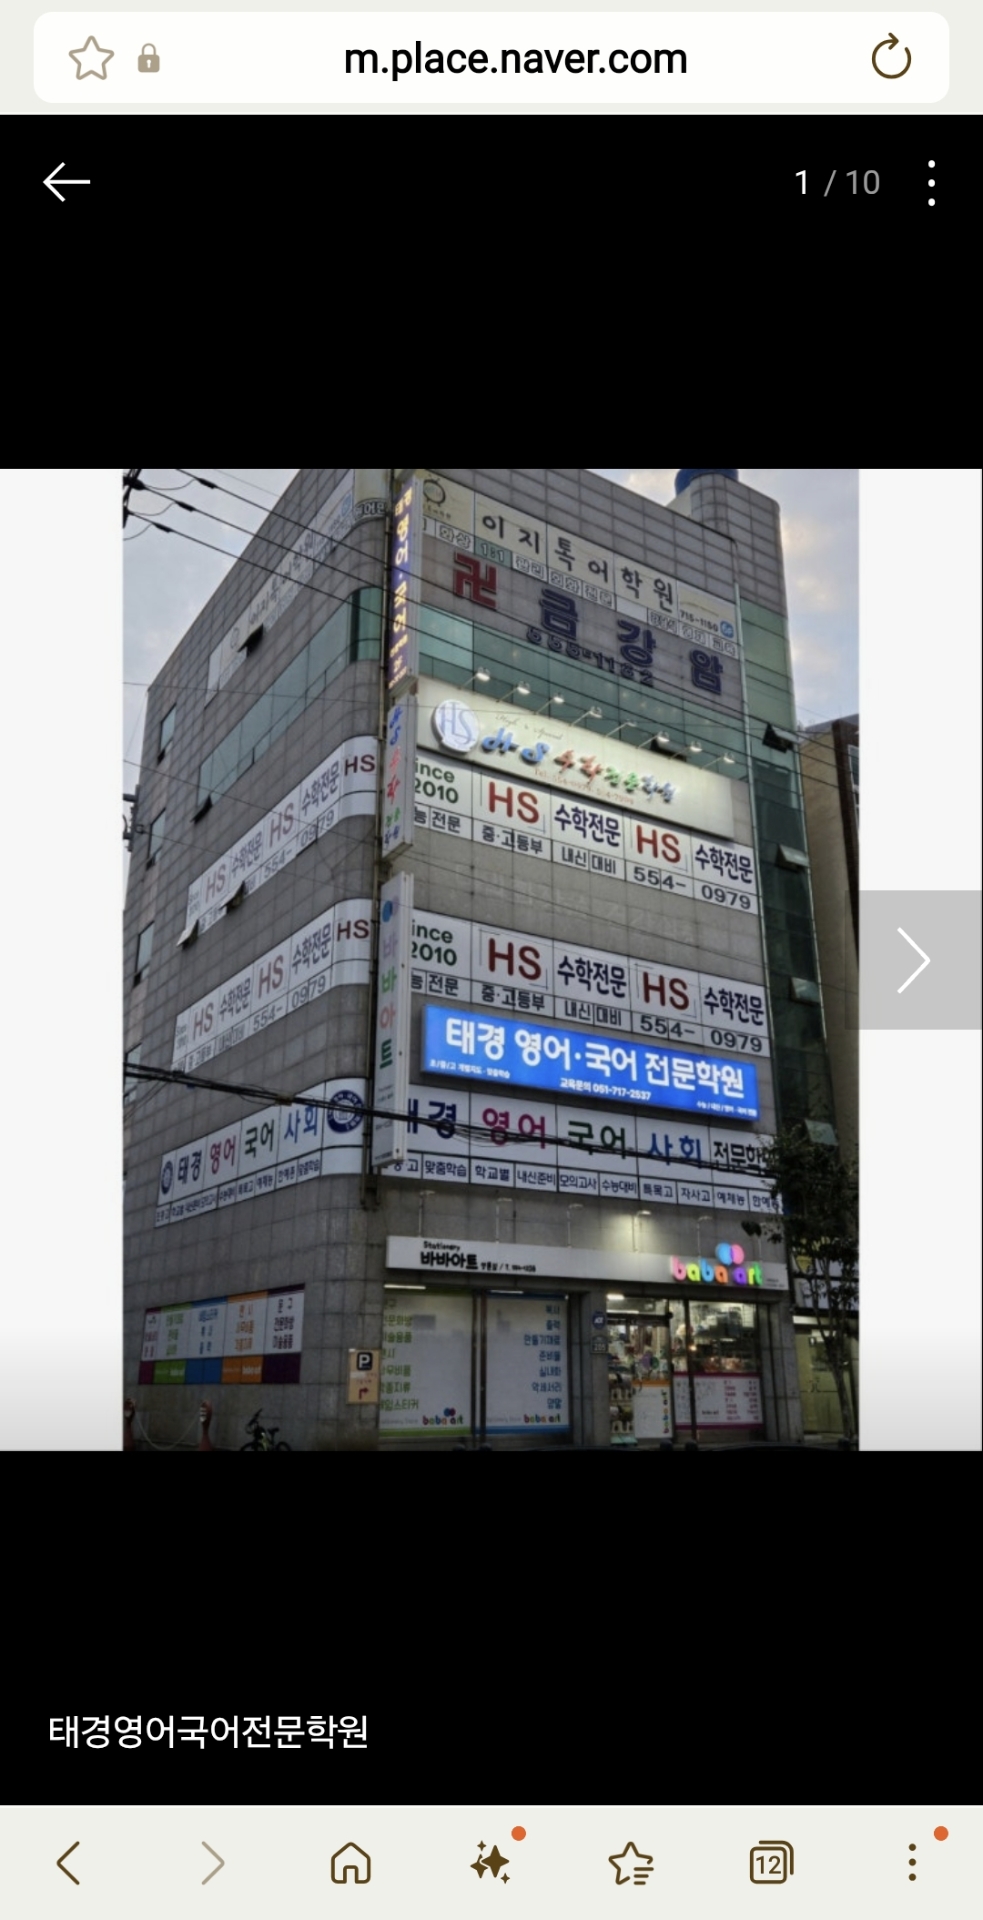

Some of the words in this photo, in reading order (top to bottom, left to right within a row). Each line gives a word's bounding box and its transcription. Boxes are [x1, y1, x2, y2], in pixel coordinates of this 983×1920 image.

[481, 542, 505, 564] 1:1
[540, 587, 724, 695] 금강암
[344, 754, 376, 777] HS
[414, 757, 455, 784] ince
[205, 863, 227, 903] HS
[269, 802, 295, 848] HS
[301, 759, 339, 817] 수학전문
[432, 810, 461, 834] 전문
[561, 846, 588, 868] 내신
[591, 853, 618, 876] 대비
[488, 781, 540, 825] HS
[553, 803, 621, 847] 수학전문
[635, 824, 682, 864] HS
[694, 843, 755, 884] 수학전문
[336, 919, 370, 942] HS
[411, 919, 454, 944] ince
[192, 1002, 215, 1041] HS
[257, 954, 284, 999] HS
[292, 922, 331, 975] 수학전문
[379, 933, 399, 1070] 바바아트
[428, 972, 459, 998] 전문
[564, 1000, 591, 1021] 내신
[595, 1005, 622, 1027] 대비
[488, 937, 542, 981] HS
[557, 955, 627, 998] 수학전문
[642, 970, 690, 1011] HS
[703, 986, 765, 1027] 수학전문
[445, 1017, 505, 1061] 태경
[514, 1027, 637, 1082] 영어·국어
[644, 1052, 745, 1099] 전문학원
[177, 1149, 203, 1185] 태경
[209, 1134, 237, 1175] 영어
[244, 1118, 275, 1159] 국어
[283, 1104, 319, 1144] 사회
[482, 1107, 546, 1150] 영어
[567, 1120, 627, 1160] 국어
[649, 1132, 704, 1169] 사회
[424, 1159, 468, 1178] 맞춤학습
[474, 1163, 511, 1182] 학교별
[516, 1169, 556, 1187] 내신준비
[559, 1173, 597, 1191] 모의고사
[601, 1179, 638, 1196] 수능대비
[680, 1187, 712, 1203] 자사고
[420, 1251, 479, 1270] 바바아트
[671, 1255, 729, 1286] baba
[733, 1260, 763, 1286] art
[359, 1353, 371, 1369] P
[539, 1367, 562, 1379] 실내화
